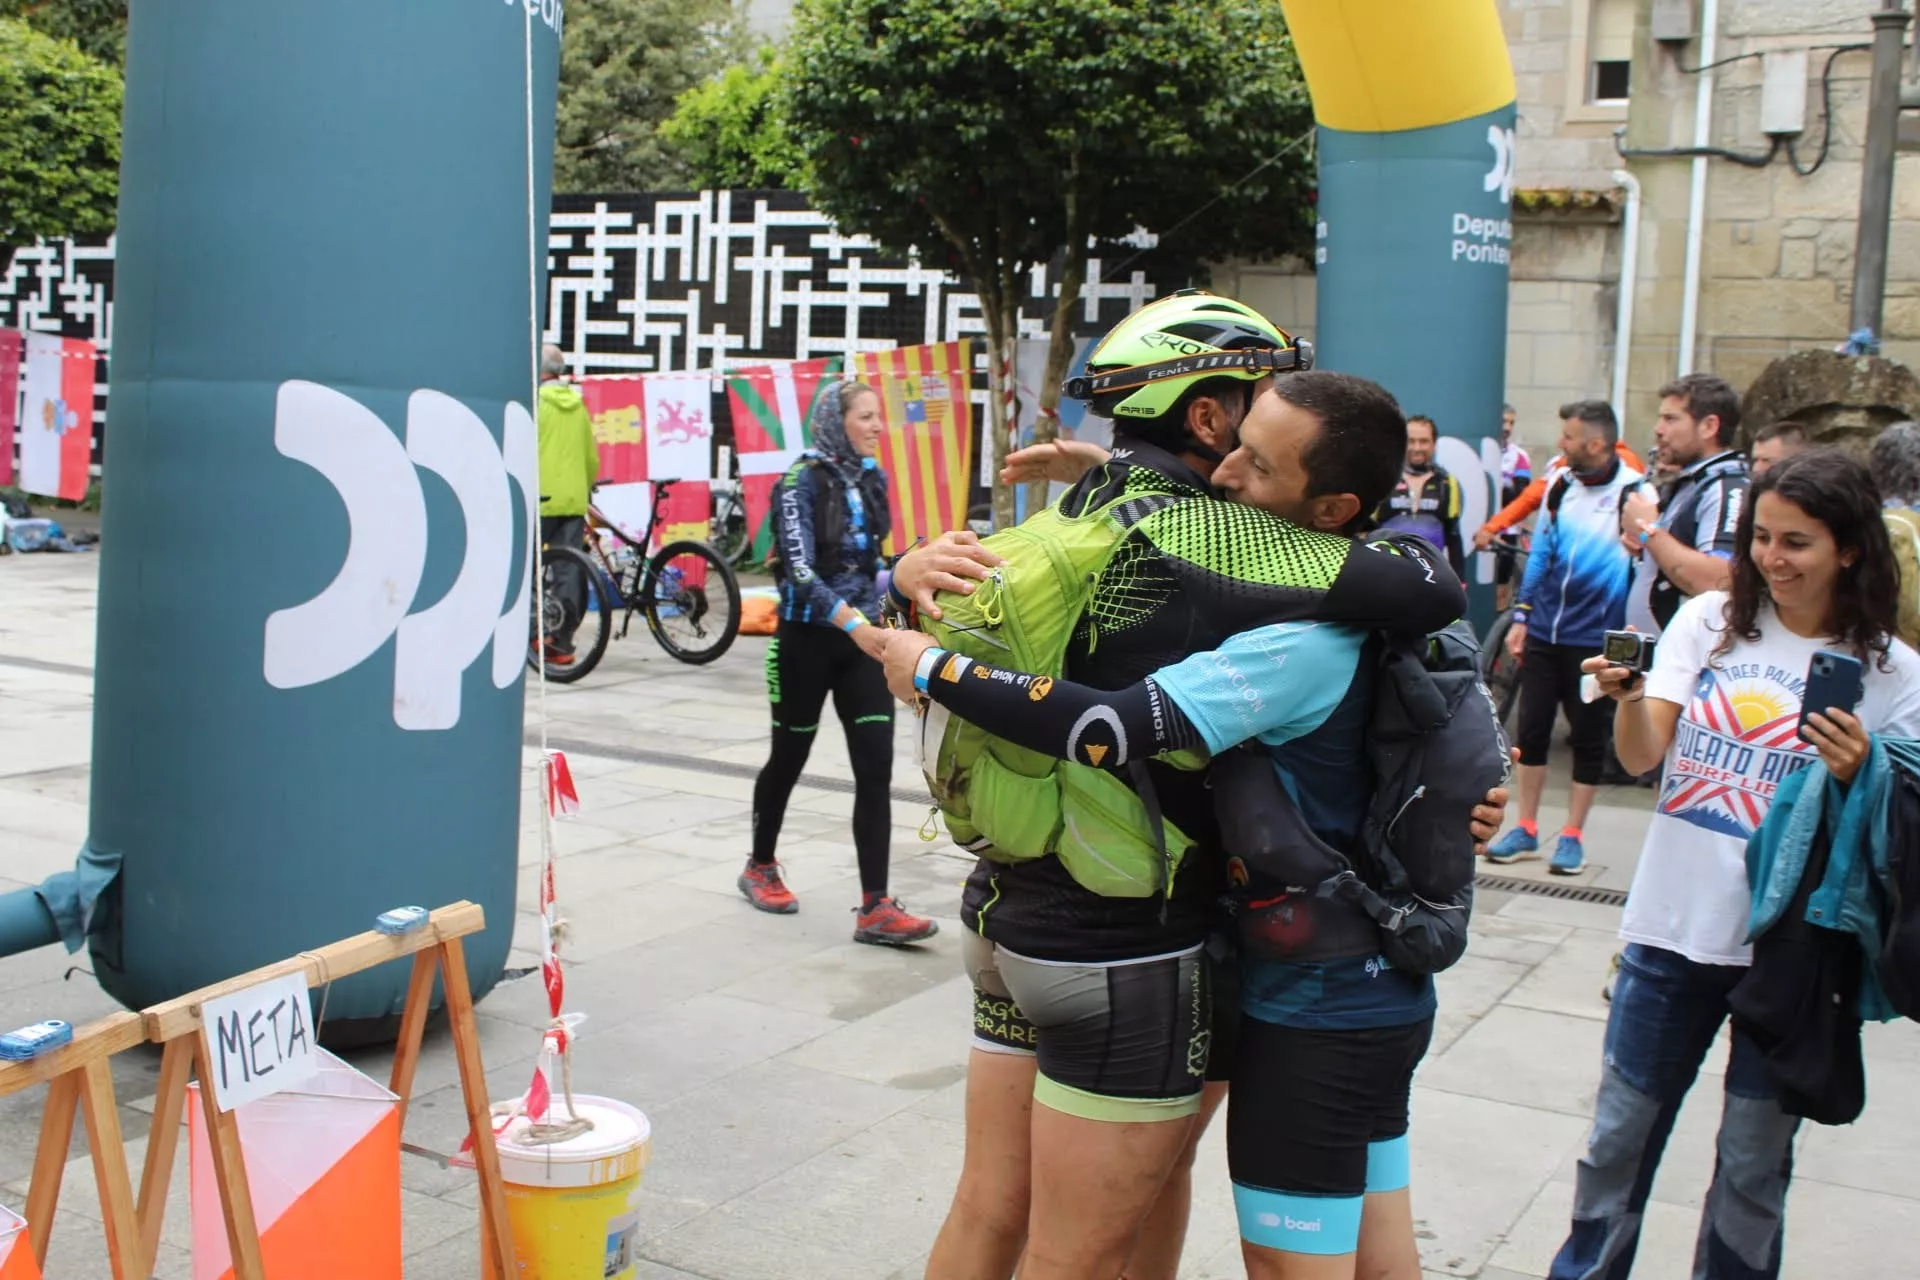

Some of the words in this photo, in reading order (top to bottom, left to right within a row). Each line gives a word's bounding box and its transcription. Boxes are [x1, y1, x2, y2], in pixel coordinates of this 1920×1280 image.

[781, 489, 816, 584] GALLAECIA
[1723, 663, 1760, 682] TRES
[1678, 760, 1735, 781] SURF
[217, 993, 308, 1090] META
